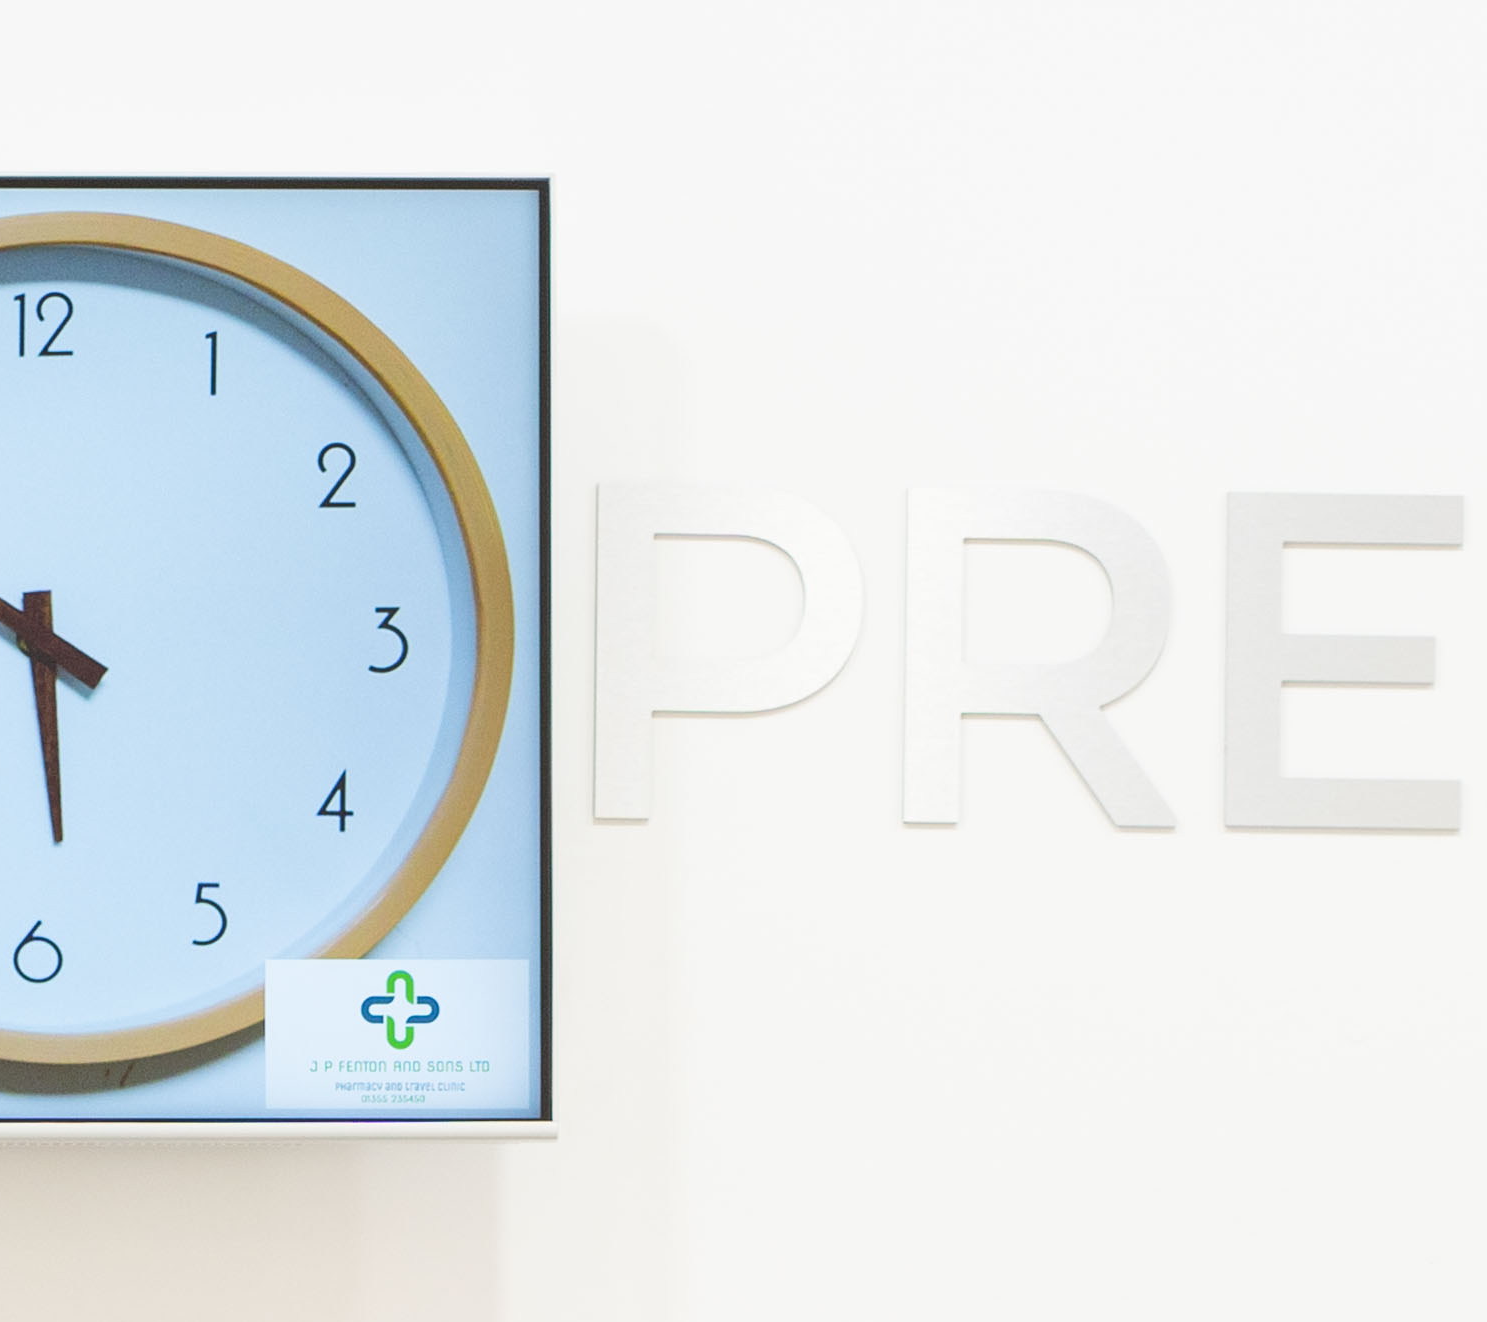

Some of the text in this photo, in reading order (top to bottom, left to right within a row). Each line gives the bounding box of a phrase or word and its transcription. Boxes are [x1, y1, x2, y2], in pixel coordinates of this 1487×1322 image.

[14, 292, 73, 357] 12
[205, 331, 217, 395] 1
[318, 443, 356, 508] 2
[369, 607, 408, 673] 3
[317, 770, 353, 832] 4
[193, 883, 227, 945] 5
[13, 921, 63, 983] 6
[309, 1060, 317, 1073] J
[324, 1060, 333, 1073] P
[393, 1060, 421, 1073] AND
[427, 1060, 463, 1073] SONS
[469, 1060, 490, 1073] LTD
